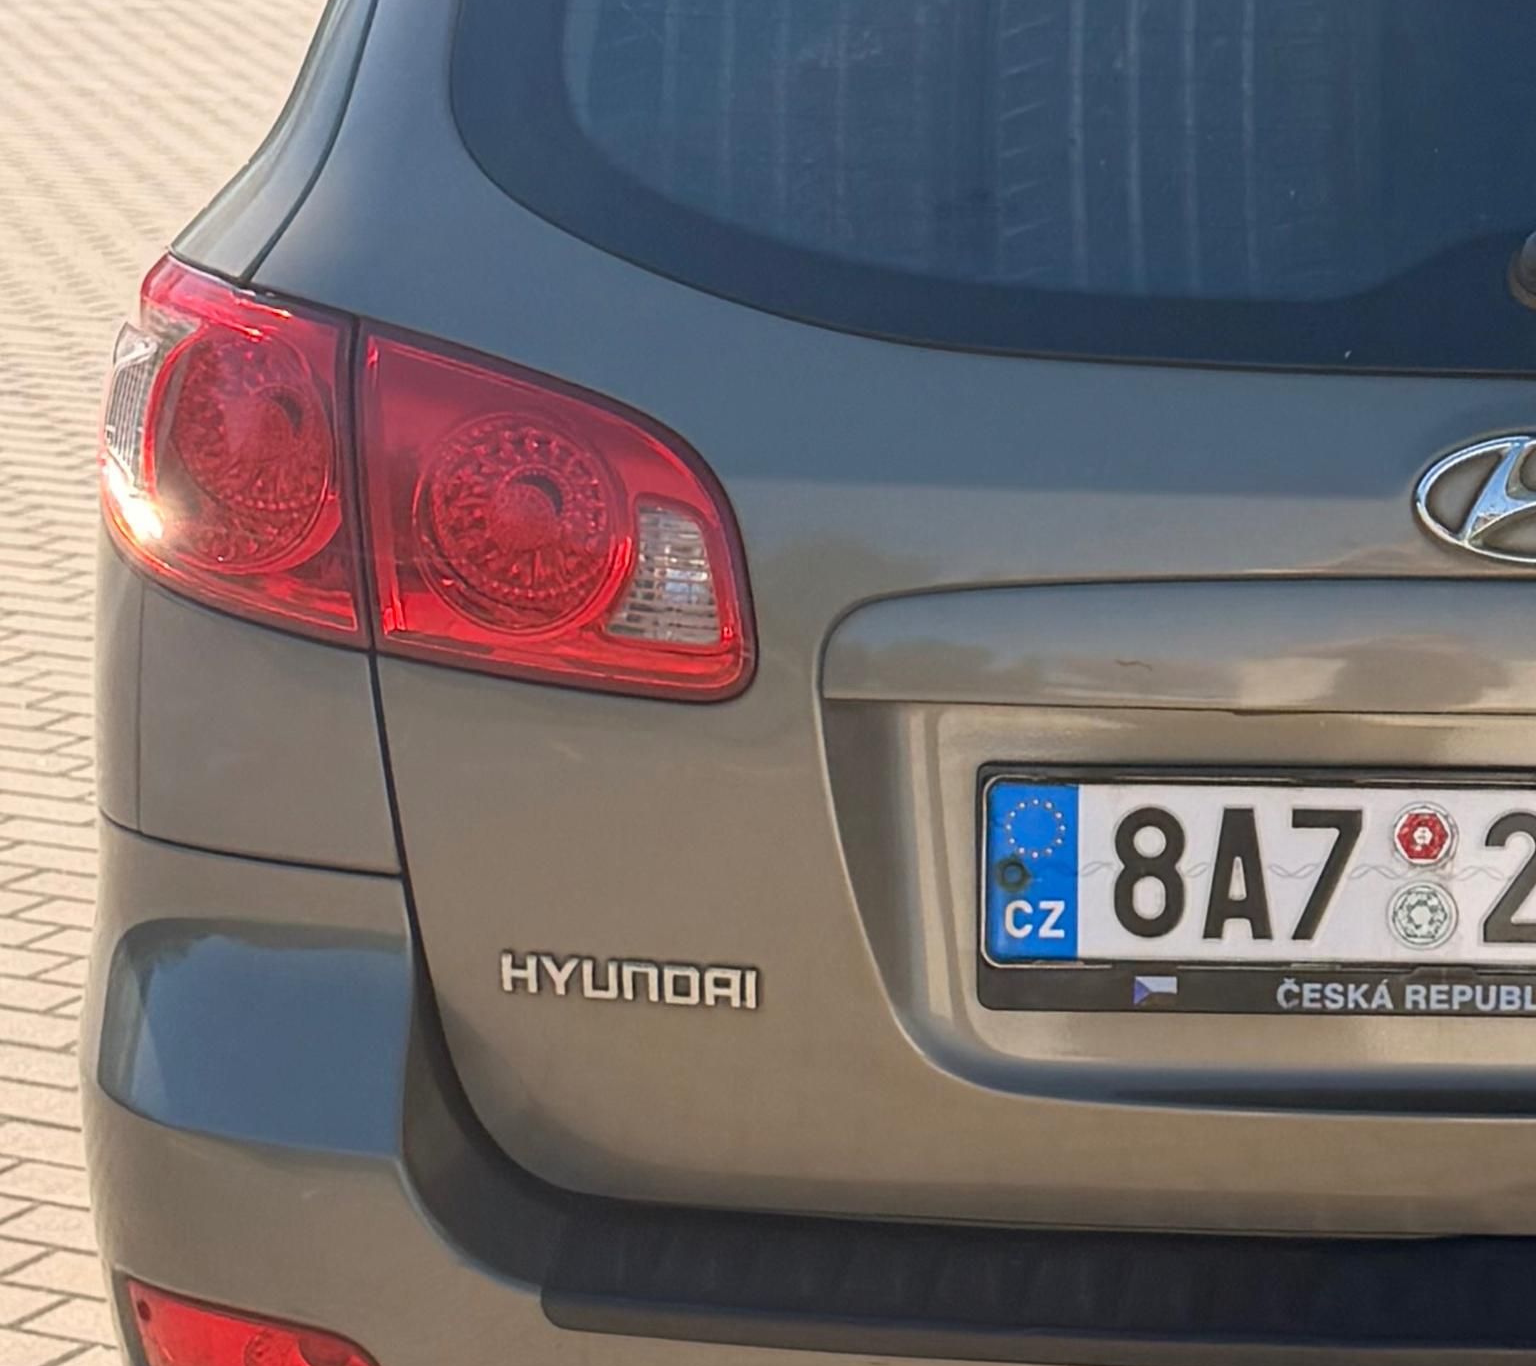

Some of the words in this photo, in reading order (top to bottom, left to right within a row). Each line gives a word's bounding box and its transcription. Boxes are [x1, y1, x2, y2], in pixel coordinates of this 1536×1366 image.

[1113, 806, 1363, 941] 8A7
[1003, 899, 1066, 940] CZ
[500, 951, 758, 1009] HYUNDAI
[1276, 978, 1393, 1010] ČESKÁ
